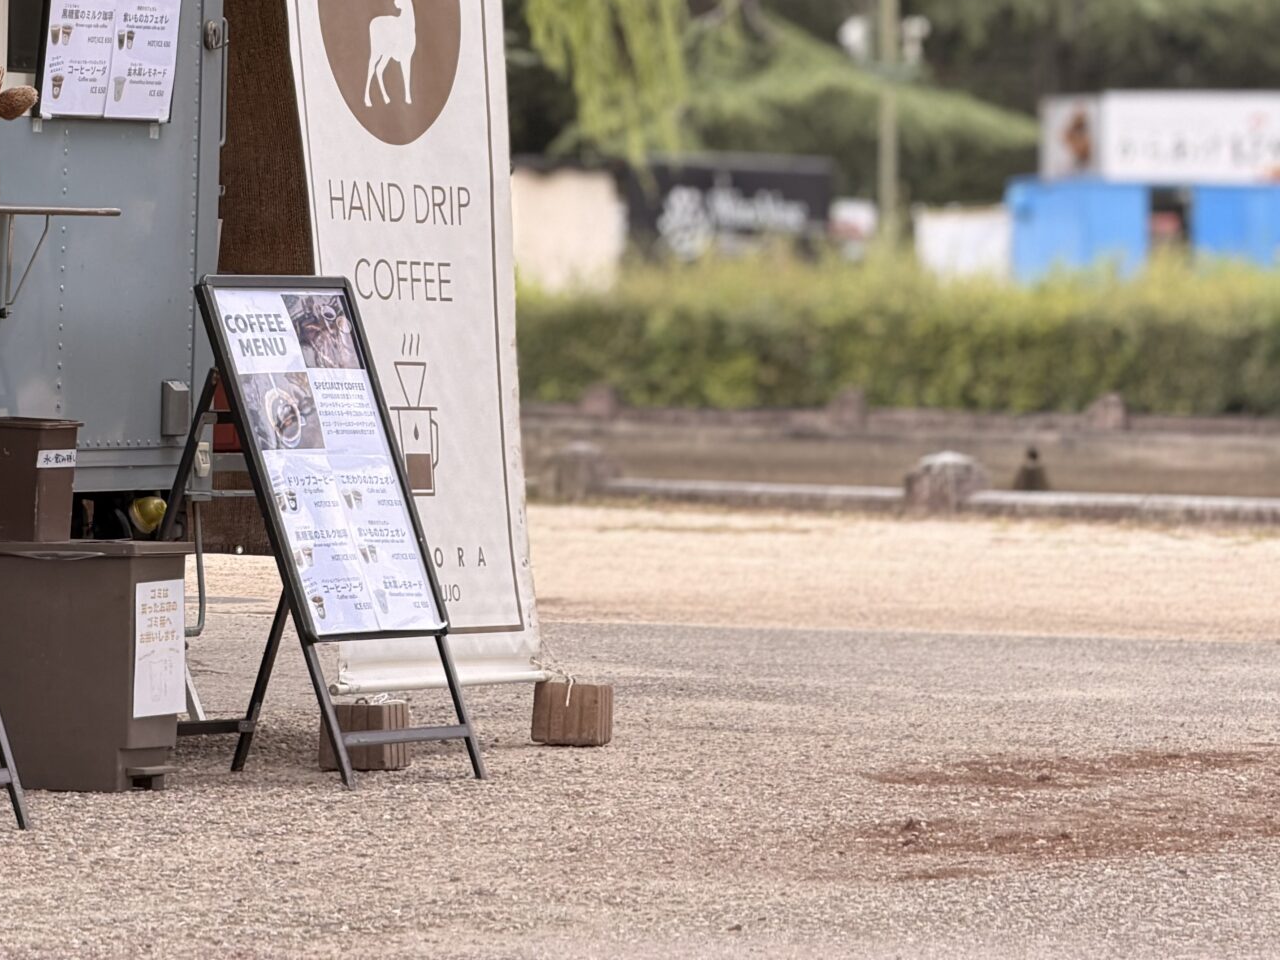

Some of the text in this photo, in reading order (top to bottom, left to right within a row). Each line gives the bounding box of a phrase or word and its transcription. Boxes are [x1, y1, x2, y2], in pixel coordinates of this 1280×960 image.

[328, 178, 471, 227] HAND DRIP
[354, 257, 453, 303] COFFEE
[224, 313, 287, 334] COFFEE
[239, 337, 287, 357] MENU
[434, 546, 487, 568] ORA
